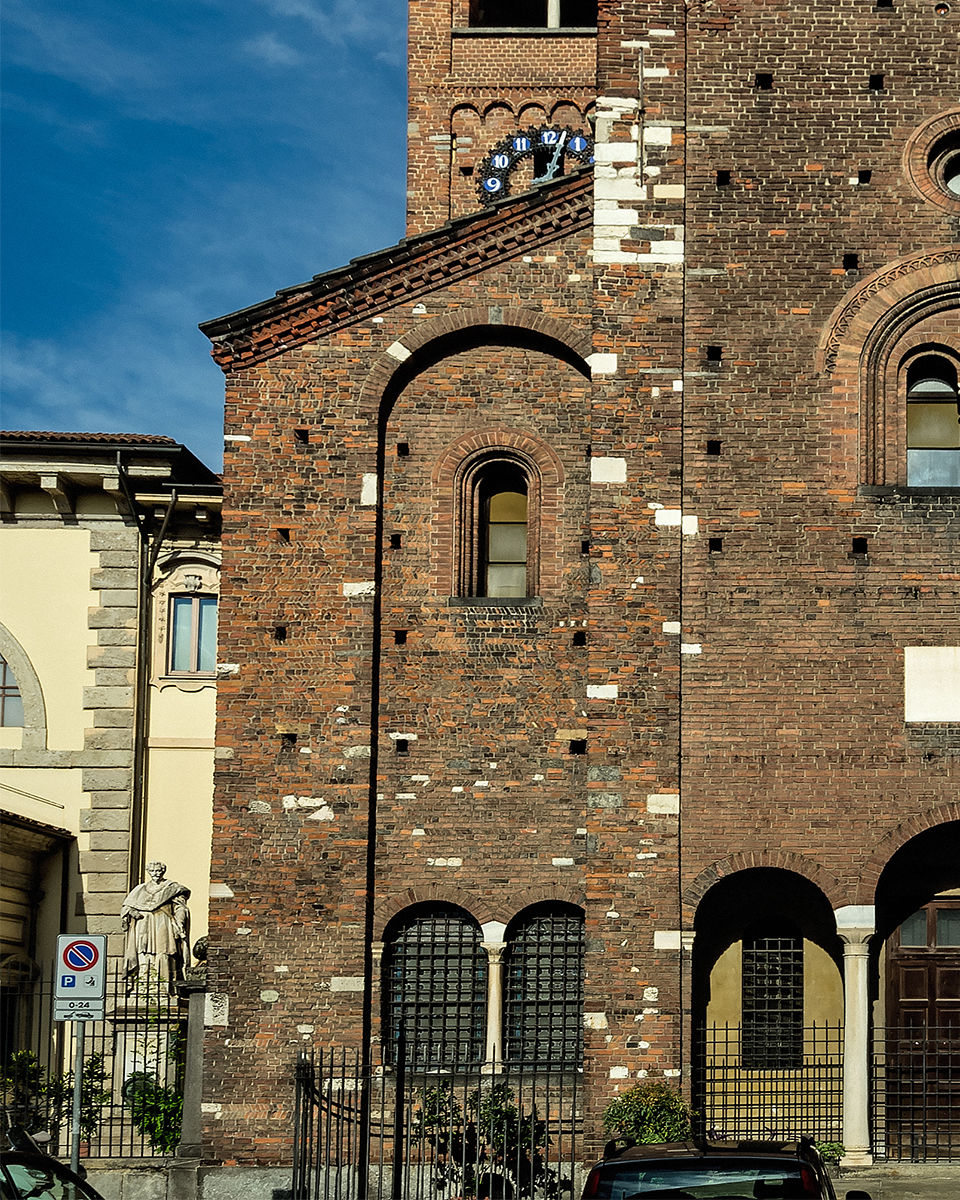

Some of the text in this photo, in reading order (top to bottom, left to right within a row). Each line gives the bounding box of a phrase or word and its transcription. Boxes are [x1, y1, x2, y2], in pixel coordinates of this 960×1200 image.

[542, 131, 558, 144] 12
[574, 137, 581, 151] 1
[515, 138, 527, 151] 11
[493, 154, 509, 168] 10
[486, 178, 501, 192] 9
[64, 977, 73, 986] P
